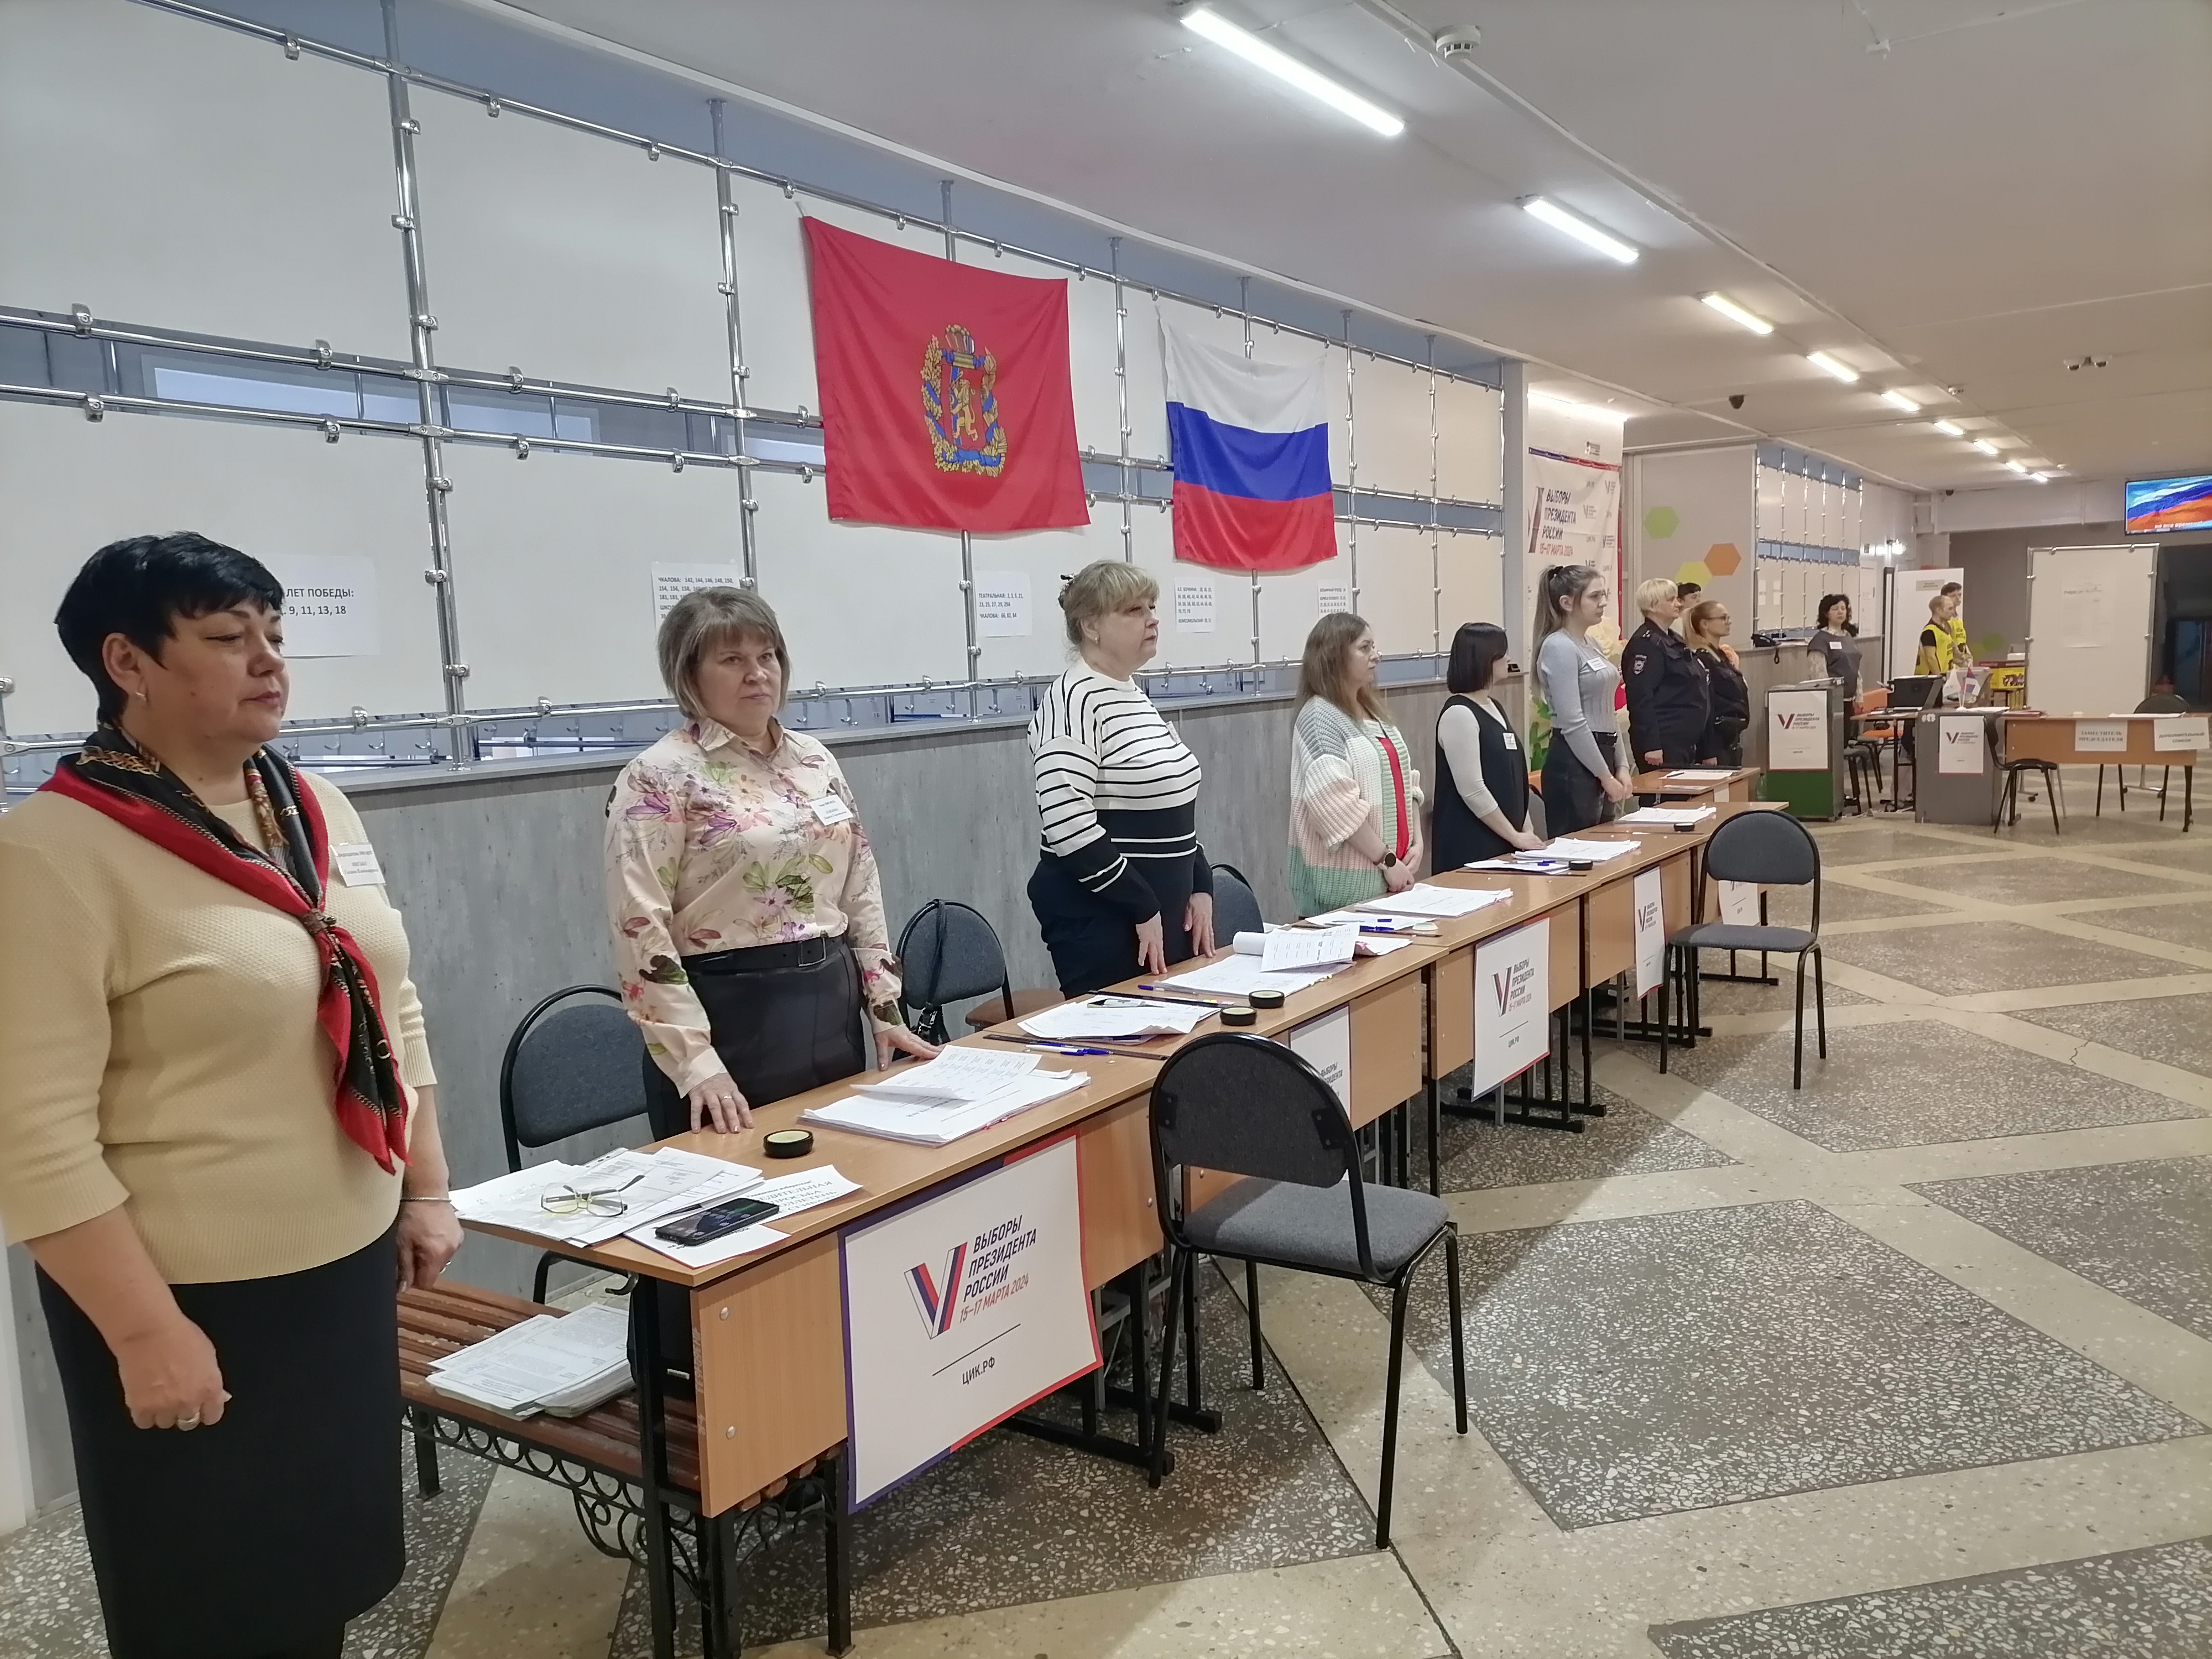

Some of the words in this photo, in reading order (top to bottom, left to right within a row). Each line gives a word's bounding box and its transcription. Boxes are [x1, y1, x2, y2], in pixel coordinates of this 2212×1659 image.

[1546, 489, 1571, 504] ВЫБОРЫ
[1544, 507, 1576, 525] ПРЕЗИДЕНТА
[1542, 525, 1563, 540] РОССИИ
[286, 588, 304, 597] ЛЕТ
[308, 588, 354, 599] ПОБЕДЫ:
[289, 606, 298, 616] 9,
[301, 606, 315, 615] 11,
[318, 606, 332, 615] 13,
[335, 606, 346, 614] 18
[1514, 958, 1530, 974] ВЫБОРЫ
[1512, 967, 1534, 987] ПРЕЗИДЕНТА
[1510, 984, 1525, 1000] РОССИИ
[759, 1181, 832, 1201] ЕДИТЕЛЬНАЯ
[973, 1214, 1022, 1254] ВЫБОРЫ
[968, 1228, 1036, 1278] ПРЕЗИДЕНТА
[963, 1263, 1009, 1302] РОССИИ
[982, 1284, 1010, 1311] МАРТА
[1010, 1273, 1029, 1295] 2024
[962, 1356, 995, 1385] ЦИК.РФ
